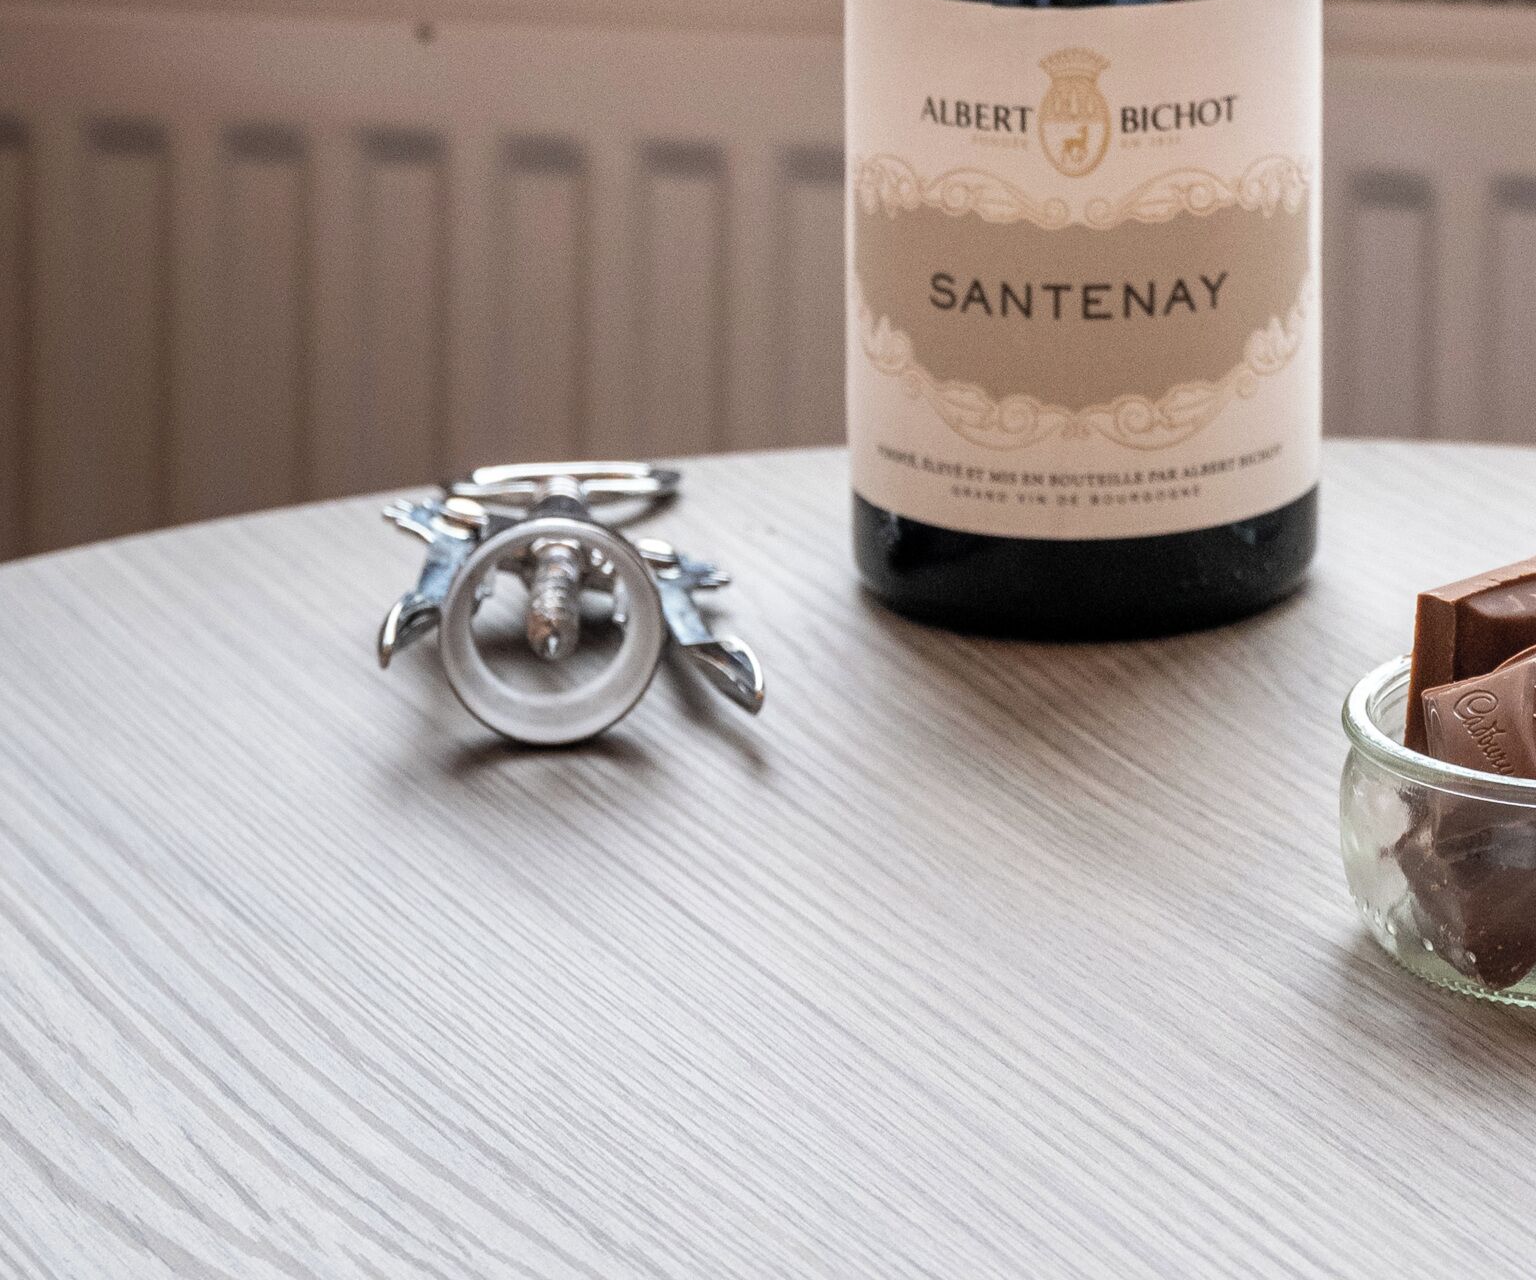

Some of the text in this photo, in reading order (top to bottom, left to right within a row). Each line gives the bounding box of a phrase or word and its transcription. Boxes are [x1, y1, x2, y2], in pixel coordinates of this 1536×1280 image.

[920, 93, 1238, 134] ALBERT BICHOT
[929, 271, 1230, 321] SANTENAY
